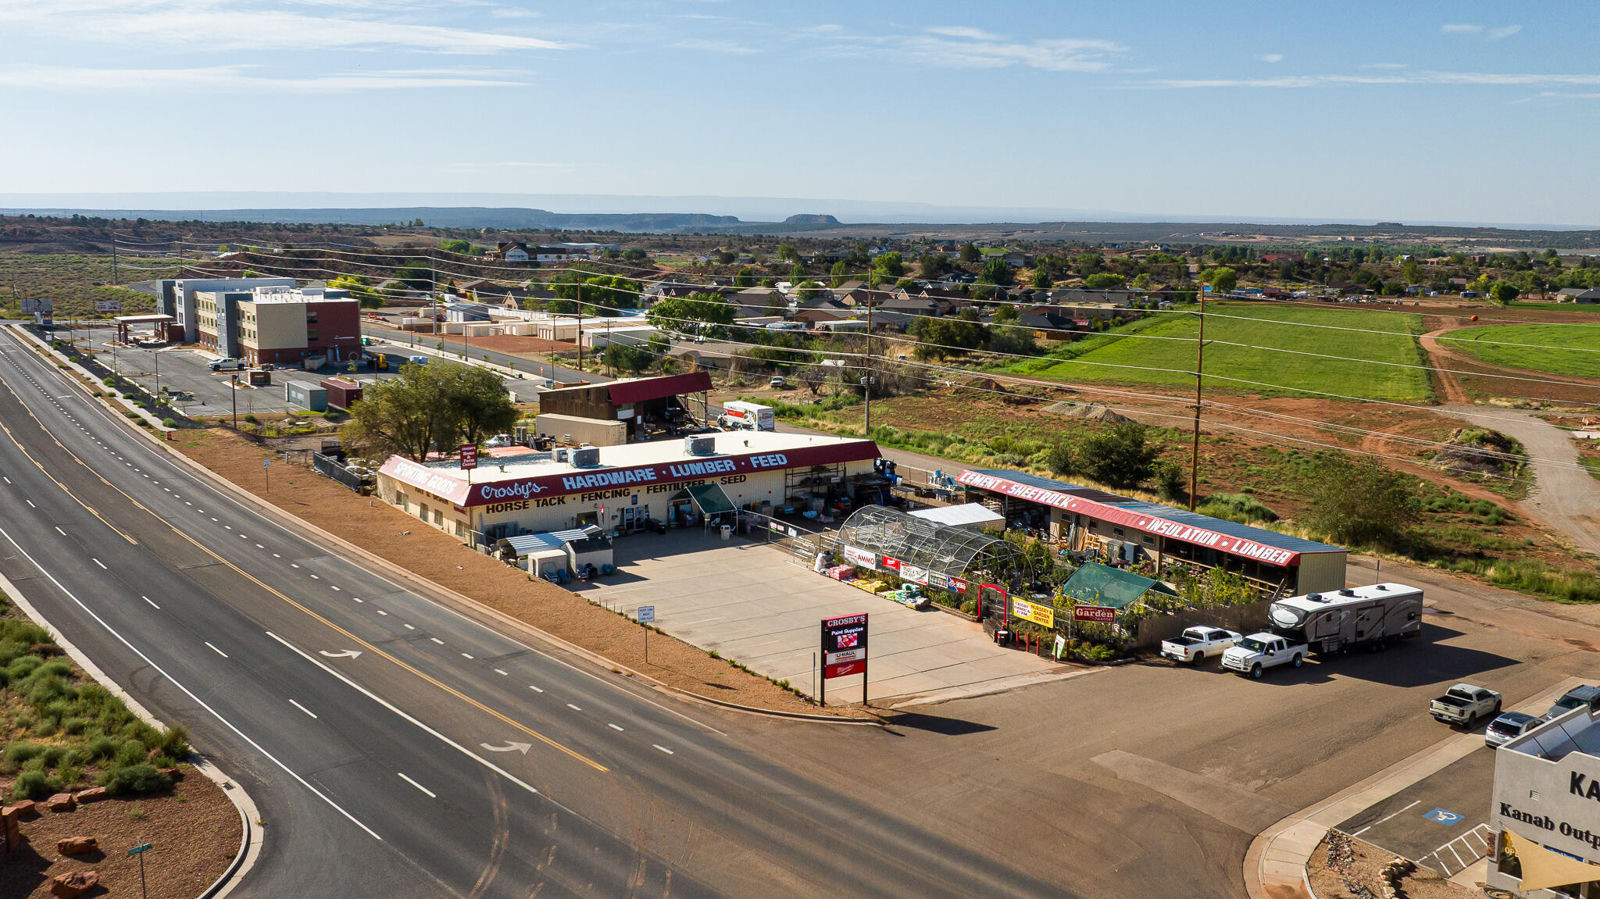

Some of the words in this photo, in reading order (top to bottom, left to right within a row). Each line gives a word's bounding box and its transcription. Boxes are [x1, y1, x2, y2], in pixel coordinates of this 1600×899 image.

[562, 467, 657, 490] HARDWARE
[669, 459, 737, 478] LUMBER
[749, 453, 788, 468] FEED
[481, 481, 548, 499] Crosby's
[486, 500, 530, 514] HORSE
[534, 496, 566, 508] TACK
[581, 488, 631, 502] FENCING
[646, 480, 706, 494] FERTILIZER
[720, 474, 747, 485] SEED
[959, 471, 1003, 489] CEMENT
[1007, 484, 1074, 508] SHEETROCK
[1145, 519, 1221, 546] INSULATION
[1231, 540, 1292, 564] LUMBER
[857, 554, 875, 565] AMMO
[827, 615, 866, 627] CROSBY'S
[1075, 607, 1114, 618] Garden
[1500, 801, 1556, 831] Kanab
